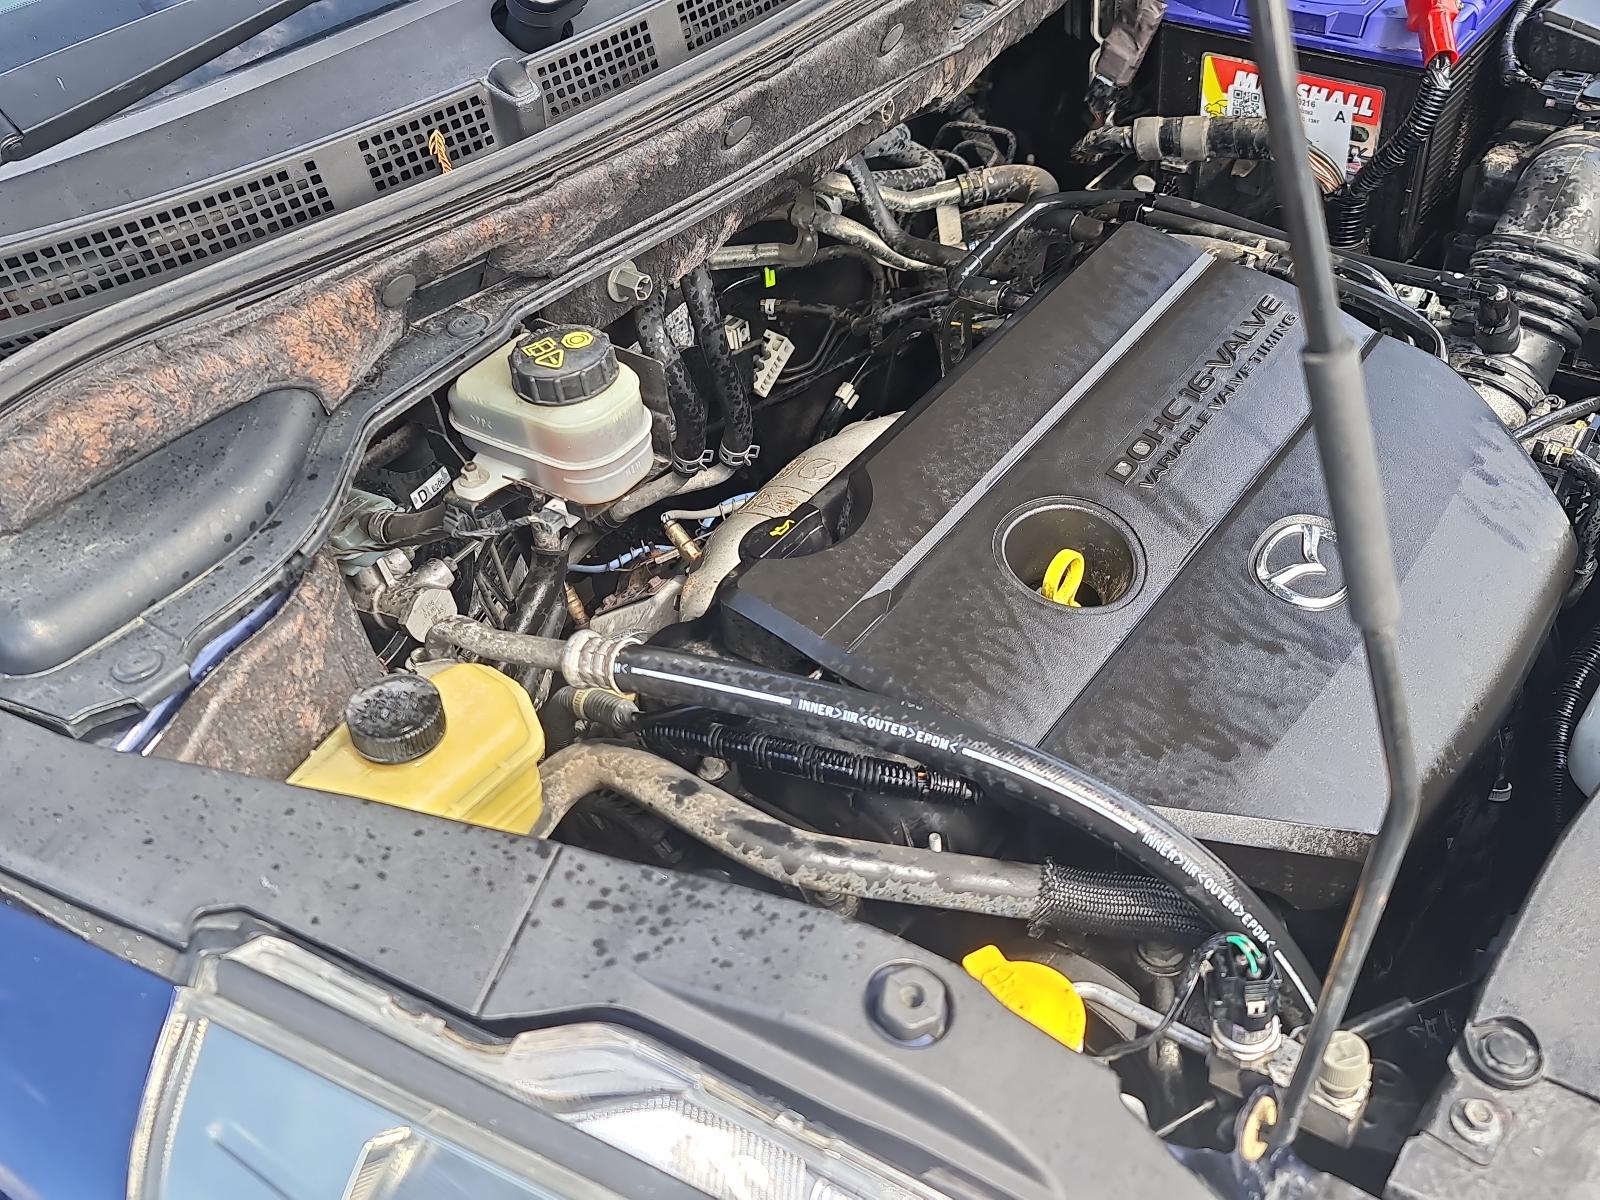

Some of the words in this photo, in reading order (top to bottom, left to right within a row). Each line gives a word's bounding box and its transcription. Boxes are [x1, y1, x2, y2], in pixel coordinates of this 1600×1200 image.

[1233, 70, 1374, 118] MSHALL
[1334, 110, 1346, 124] A
[1139, 410, 1215, 489] VARIABLE
[1207, 363, 1255, 411] VALVE
[1250, 312, 1299, 364] TIMING
[1105, 397, 1194, 487] DOHC
